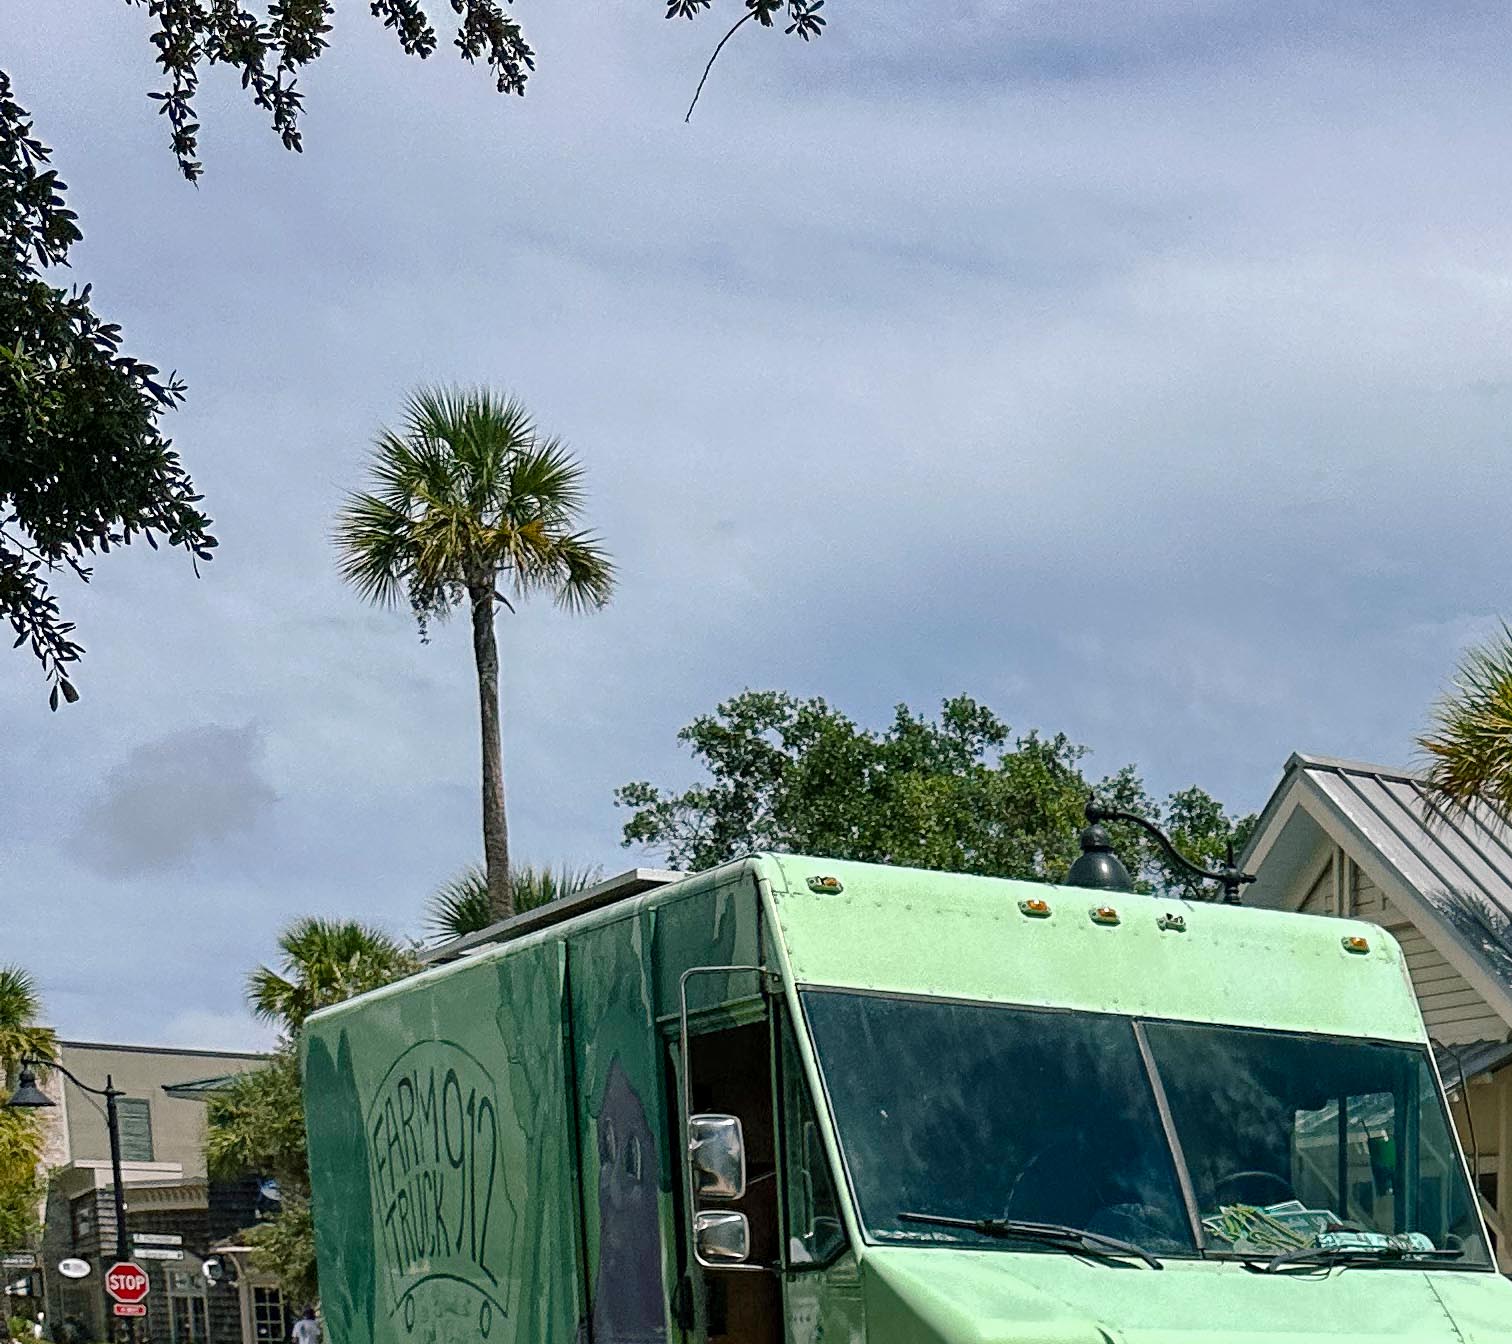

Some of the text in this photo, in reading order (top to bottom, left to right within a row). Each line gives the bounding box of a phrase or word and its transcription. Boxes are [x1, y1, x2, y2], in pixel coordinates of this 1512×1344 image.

[374, 1067, 439, 1208] FARM
[386, 1169, 451, 1277] TRUCK
[109, 1274, 145, 1290] STOP
